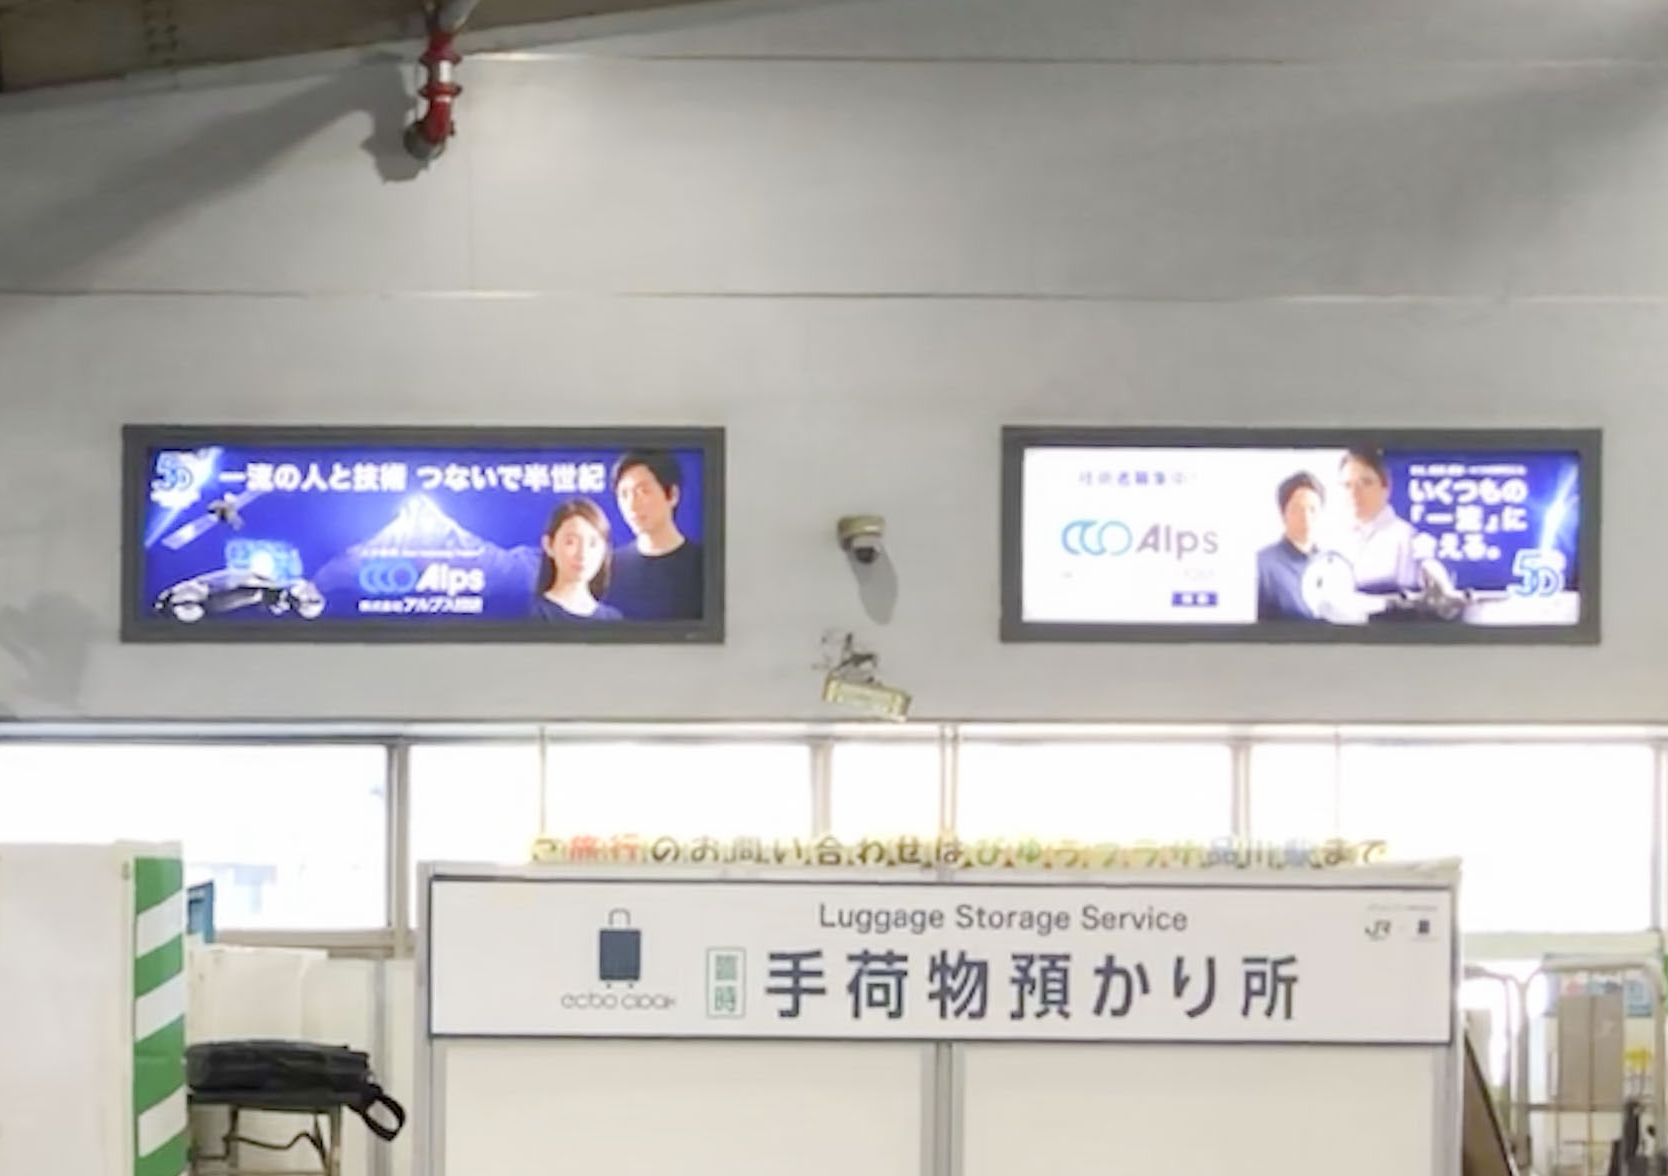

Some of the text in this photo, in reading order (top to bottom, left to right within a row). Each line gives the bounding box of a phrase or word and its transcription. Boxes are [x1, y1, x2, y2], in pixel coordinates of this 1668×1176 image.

[416, 463, 607, 493] つないで半世紀
[1408, 478, 1528, 505] いくつもの
[1135, 522, 1220, 561] Alps
[415, 562, 485, 597] Alps
[819, 903, 1189, 934] Luggage Storage Service
[764, 948, 1299, 1021] 手荷物預かり所
